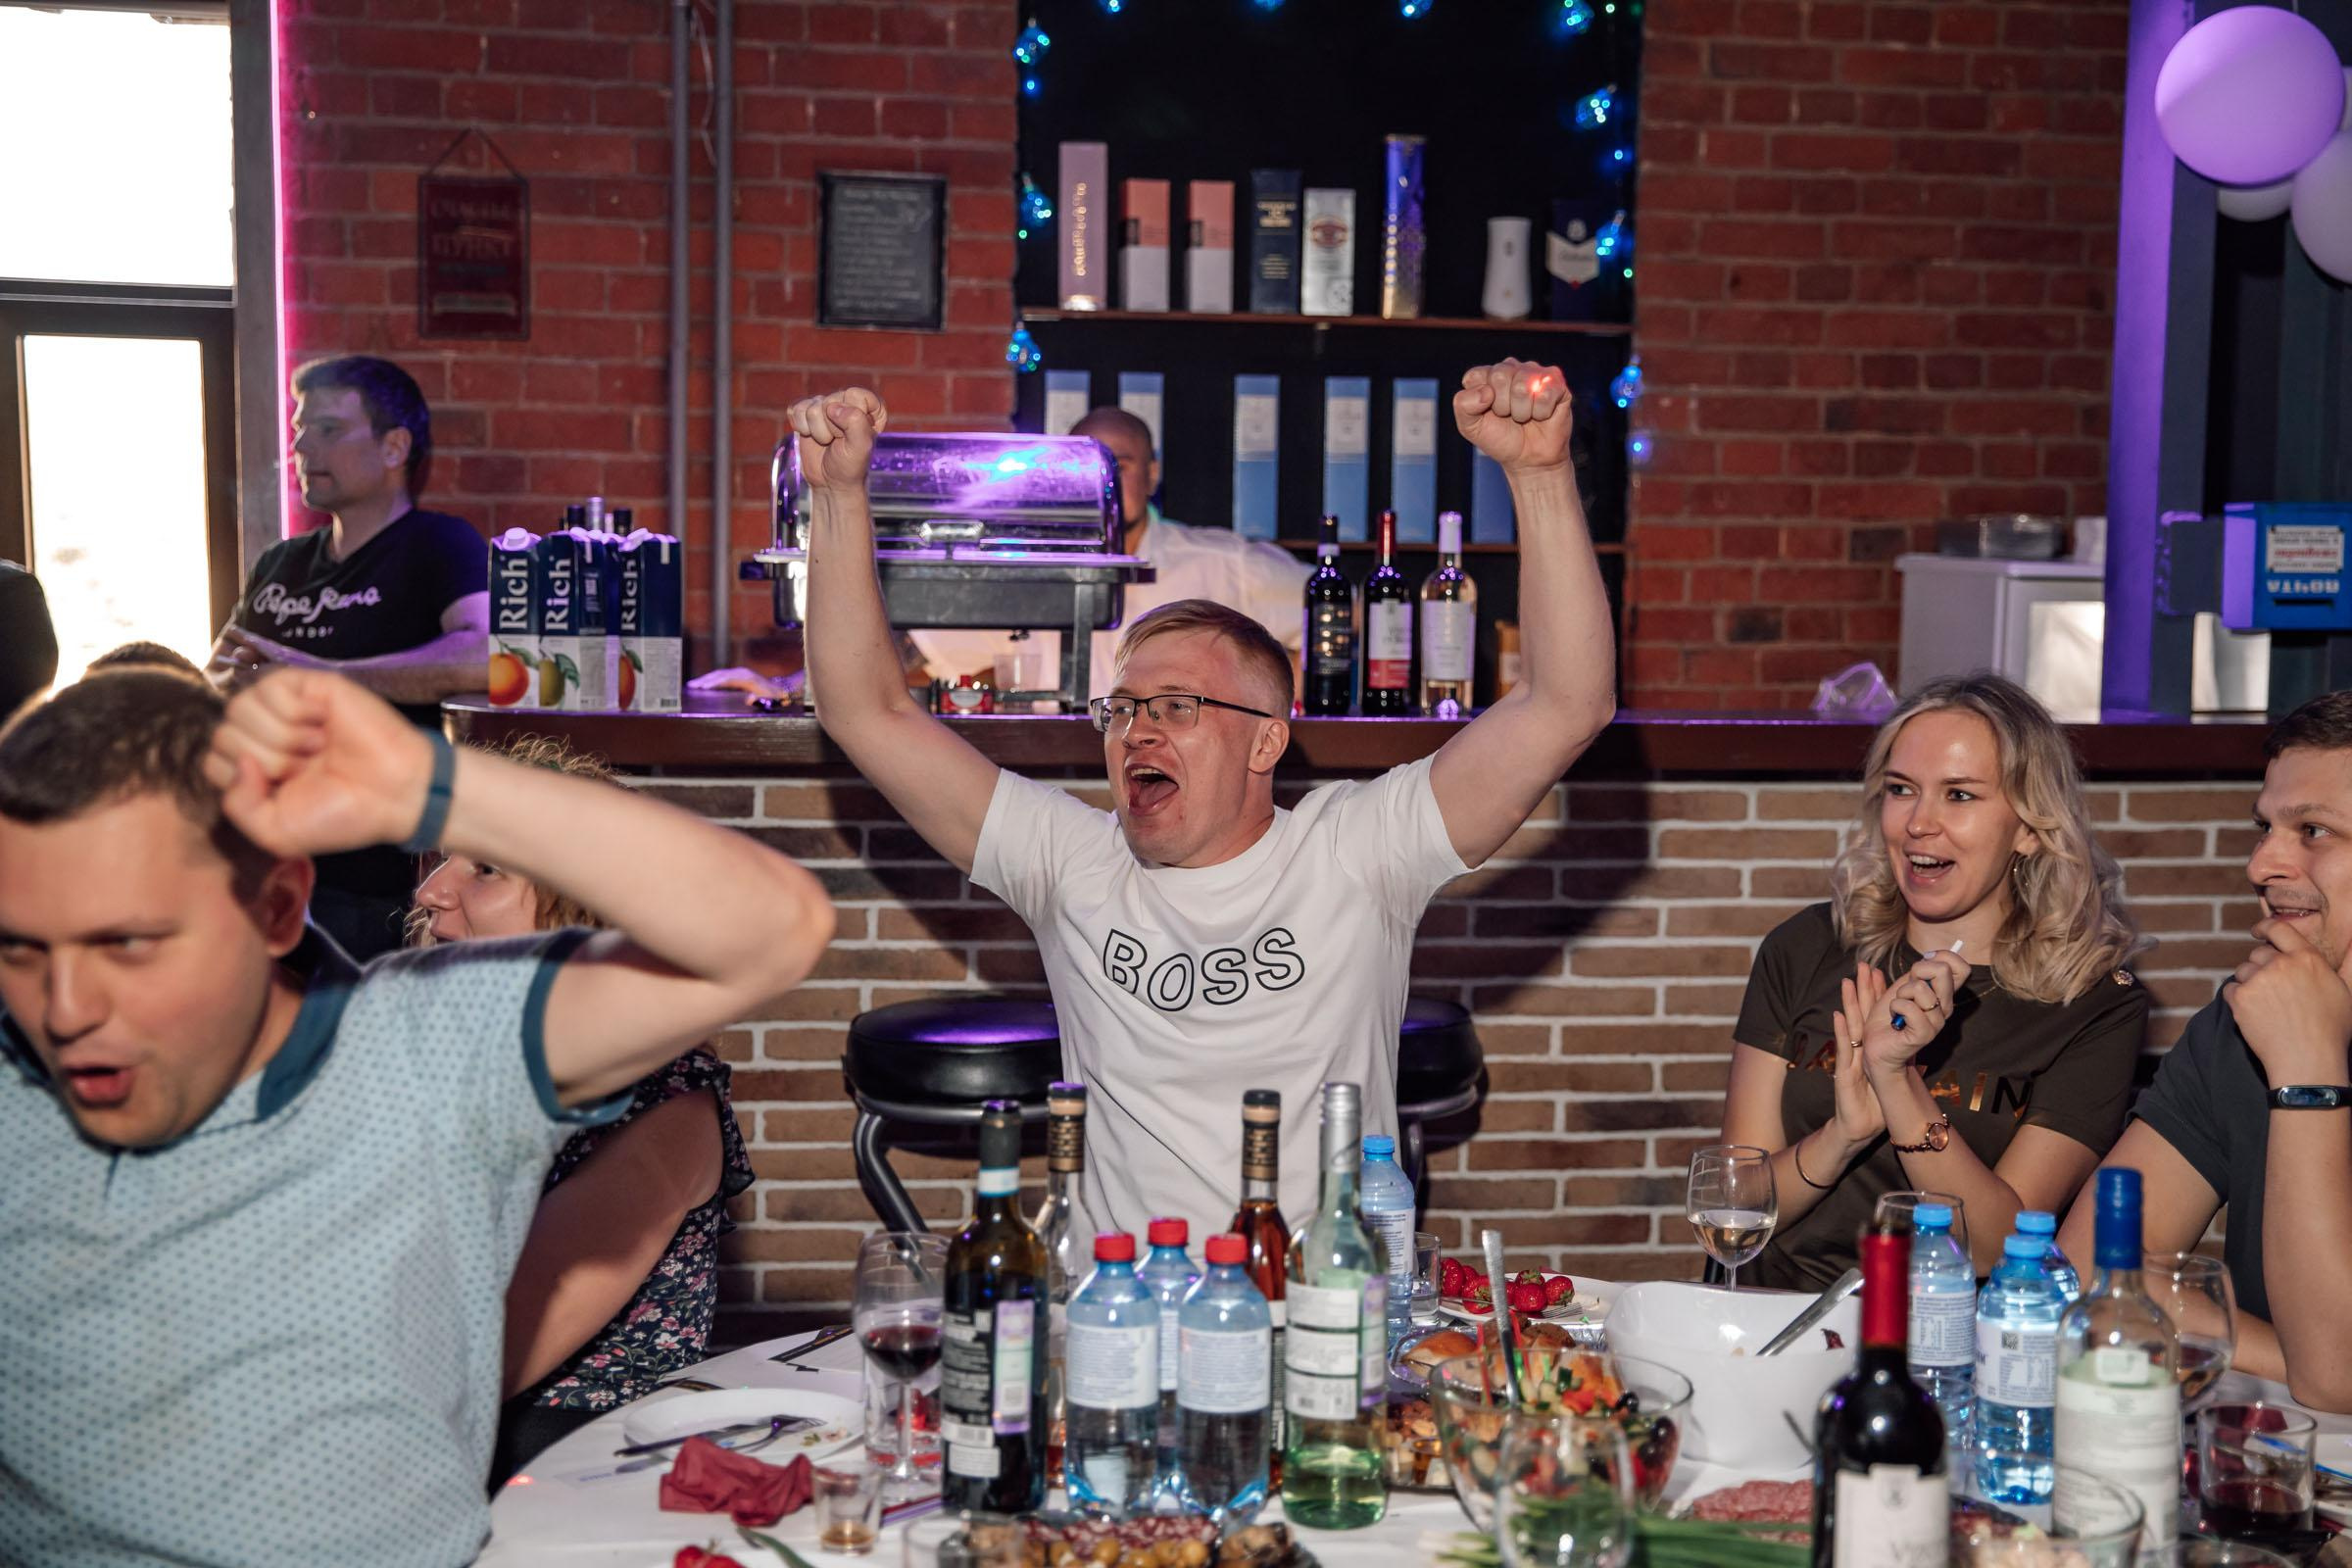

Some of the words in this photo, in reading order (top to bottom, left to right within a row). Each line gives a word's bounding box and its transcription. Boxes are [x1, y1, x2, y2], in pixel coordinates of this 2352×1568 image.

[253, 582, 313, 625] Pepe
[498, 558, 529, 630] Rich
[545, 558, 572, 631] Rich
[620, 560, 638, 631] Rich
[1102, 927, 1305, 1011] BOSS
